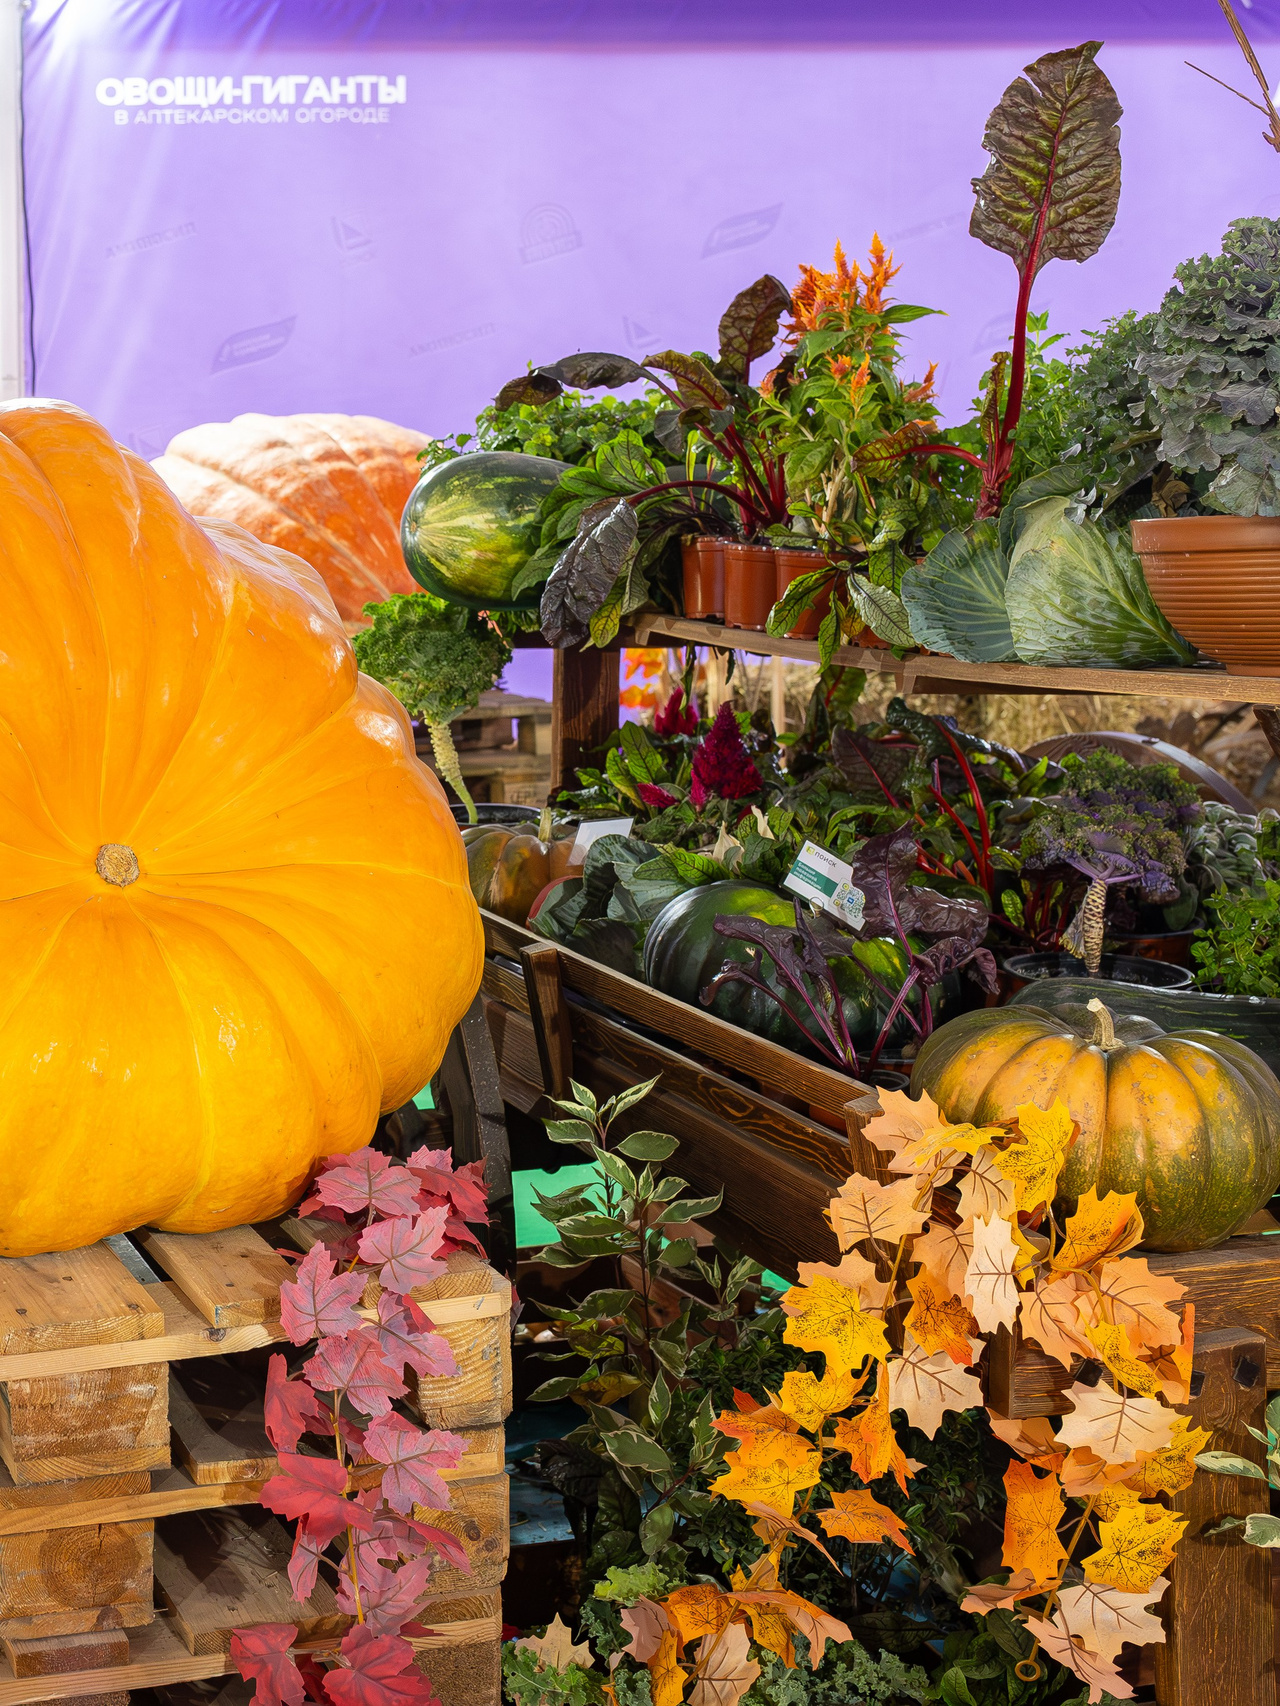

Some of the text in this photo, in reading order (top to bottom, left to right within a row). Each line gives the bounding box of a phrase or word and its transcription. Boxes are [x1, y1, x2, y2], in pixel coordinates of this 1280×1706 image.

[95, 75, 407, 108] ОВОЩИ-ГИГАНТЫ
[114, 106, 390, 125] В АПТЕКАРСКОМ ОГОРОДЕ
[814, 851, 837, 868] ПОИСК
